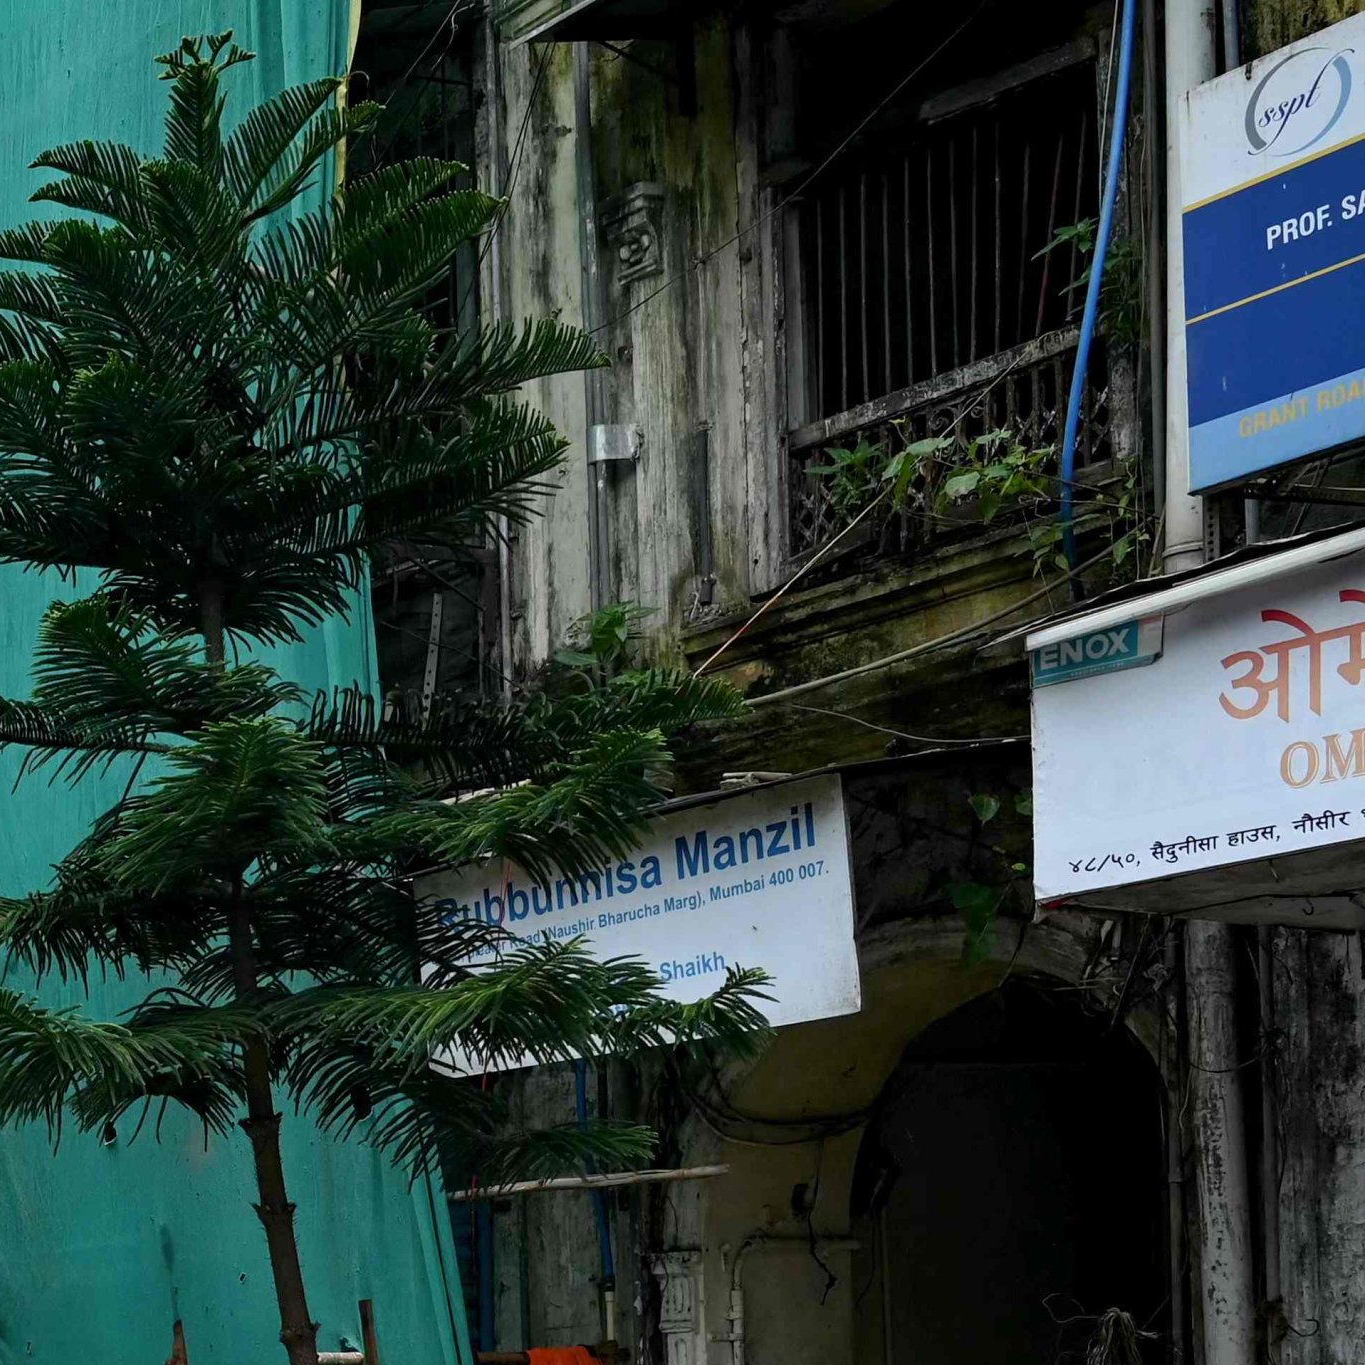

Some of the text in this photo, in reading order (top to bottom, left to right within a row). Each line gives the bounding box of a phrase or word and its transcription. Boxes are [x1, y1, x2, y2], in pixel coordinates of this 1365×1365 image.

[1267, 204, 1333, 251] PROF.
[1239, 399, 1308, 438] GRANT
[1040, 628, 1130, 670] ENOX
[675, 803, 816, 880] Manzil
[1150, 835, 1219, 863] सैदुनीसा
[1227, 825, 1281, 847] हाउस,
[1292, 811, 1351, 834] नौसीर
[598, 903, 660, 929] Bharucha
[664, 890, 704, 916] Marg),
[709, 875, 765, 901] Mumbai
[768, 869, 793, 887] 400
[798, 860, 830, 881] 007.
[660, 951, 726, 984] Shaikh
